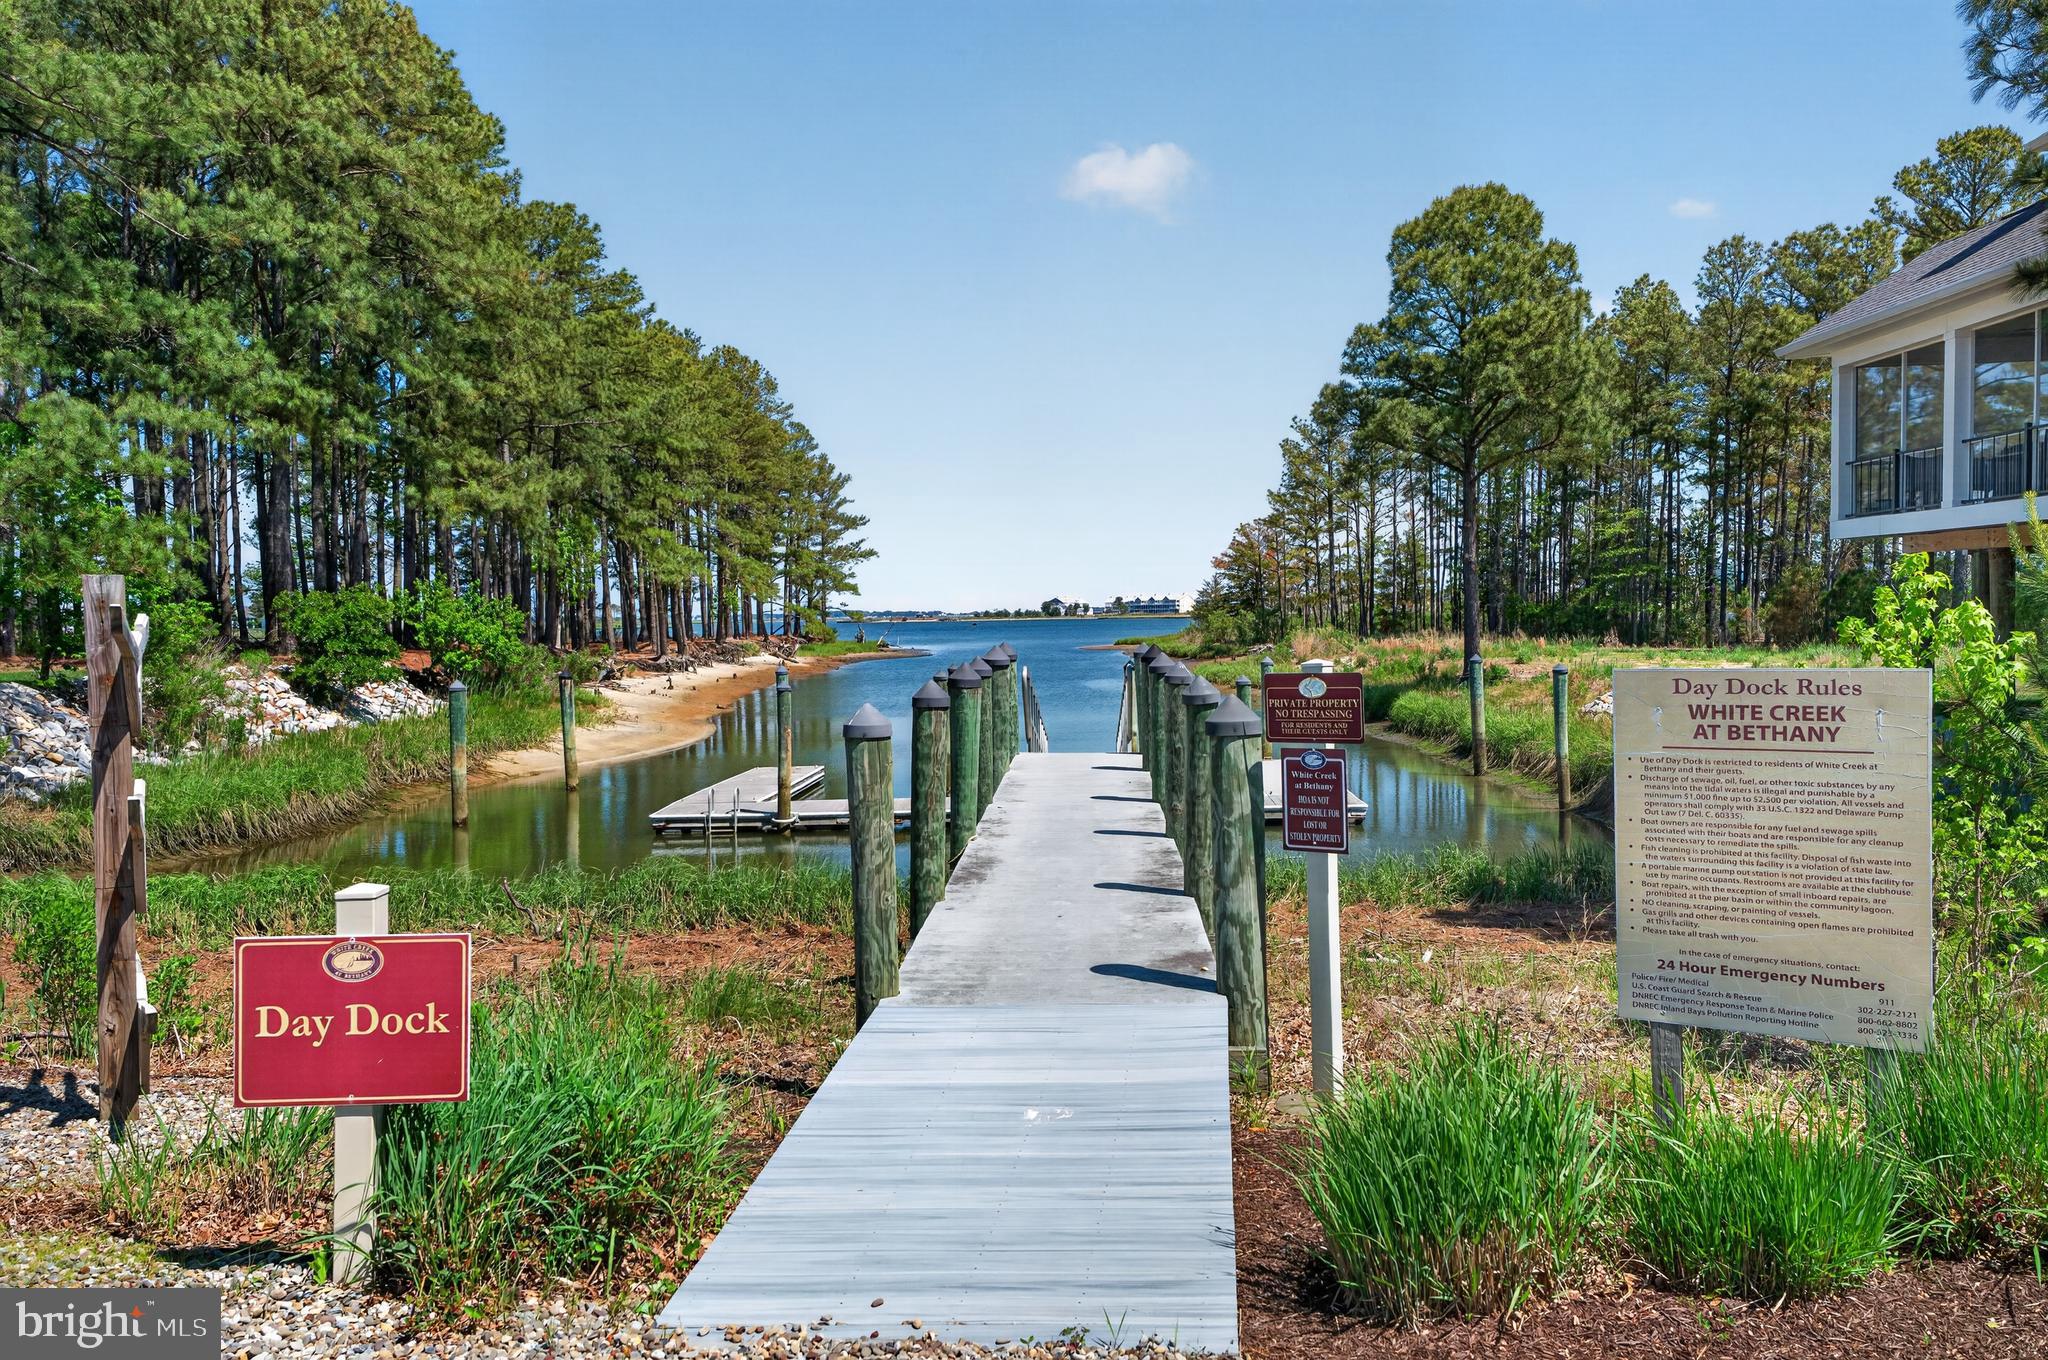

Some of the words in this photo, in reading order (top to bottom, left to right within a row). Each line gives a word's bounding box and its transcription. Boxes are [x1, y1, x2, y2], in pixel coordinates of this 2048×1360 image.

[1671, 677, 1717, 699] Day
[1724, 678, 1788, 695] Dock
[1796, 678, 1862, 696] Rules
[1269, 699, 1308, 708] PRIVATE
[1310, 699, 1359, 708] PROPERTY
[1275, 709, 1289, 718] NO
[1291, 709, 1353, 719] TRESPASSING
[1687, 704, 1763, 720] WHITE
[1769, 704, 1846, 722] CREEK
[1693, 724, 1721, 740] AT
[1727, 724, 1841, 742] BETHANY
[1644, 764, 1676, 773] Bethany
[1665, 756, 1681, 765] Day
[1764, 760, 1802, 768] residents
[1804, 760, 1814, 768] of
[1815, 761, 1840, 769] White
[1291, 770, 1313, 779] White
[1315, 771, 1337, 780] Creek
[1639, 774, 1678, 783] Discharge
[1690, 777, 1722, 785] sewage,
[1739, 777, 1757, 785] fuel,
[1816, 780, 1864, 789] substances
[1866, 782, 1877, 790] by
[1304, 782, 1334, 792] Bethany
[1318, 796, 1330, 805] NOT
[1712, 793, 1728, 801] fine
[1753, 795, 1781, 803] $2,500
[1799, 798, 1838, 806] violation.
[1854, 800, 1884, 808] vessels
[1290, 807, 1328, 817] RESPONSIBLE
[1704, 803, 1734, 811] comply
[1795, 806, 1814, 814] 1322
[1835, 808, 1875, 816] Delaware
[1877, 810, 1903, 819] Pump
[1303, 820, 1318, 829] LOST
[1290, 832, 1312, 841] STOLEN
[1312, 833, 1341, 843] PROPERTY
[1640, 843, 1656, 851] Fish
[1657, 845, 1690, 855] cleaning
[1700, 848, 1742, 856] prohibited
[1770, 851, 1799, 861] facility.
[1801, 853, 1837, 862] Disposal
[1839, 855, 1848, 863] of
[1849, 856, 1864, 864] fish
[1894, 859, 1911, 867] into
[1655, 899, 1691, 910] cleaning,
[1692, 904, 1729, 913] scraping,
[1741, 907, 1776, 916] painting
[1642, 925, 1667, 934] Please
[1688, 949, 1701, 957] the
[1732, 955, 1778, 965] emergency
[1780, 957, 1823, 968] situations,
[1825, 963, 1860, 972] contact:
[1631, 972, 1657, 981] Police/
[1677, 977, 1708, 986] Medical
[1657, 958, 1675, 970] 24
[1679, 960, 1716, 974] Hour
[1720, 964, 1807, 986] Emergency
[1811, 973, 1885, 991] Numbers
[1631, 981, 1646, 989] U.S.
[1647, 983, 1669, 992] Coast
[1670, 986, 1695, 994] Guard
[1696, 988, 1723, 998] Search
[1733, 992, 1761, 1002] Rescue
[1632, 991, 1658, 1000] DNREC
[1660, 994, 1704, 1006] Emergency
[1705, 999, 1744, 1010] Response
[1745, 1003, 1767, 1012] Team
[1777, 1007, 1807, 1017] Marine
[1808, 1010, 1833, 1020] Police
[1878, 998, 1894, 1006] 911
[1632, 1001, 1658, 1010] DNREC
[1687, 1007, 1705, 1016] Bays
[1707, 1009, 1743, 1019] Pollution
[1745, 1013, 1786, 1026] Reporting
[1788, 1019, 1819, 1028] Hotline
[1857, 1006, 1916, 1018] 302-227-2121
[255, 1005, 334, 1047] Day
[345, 1002, 450, 1036] Dock
